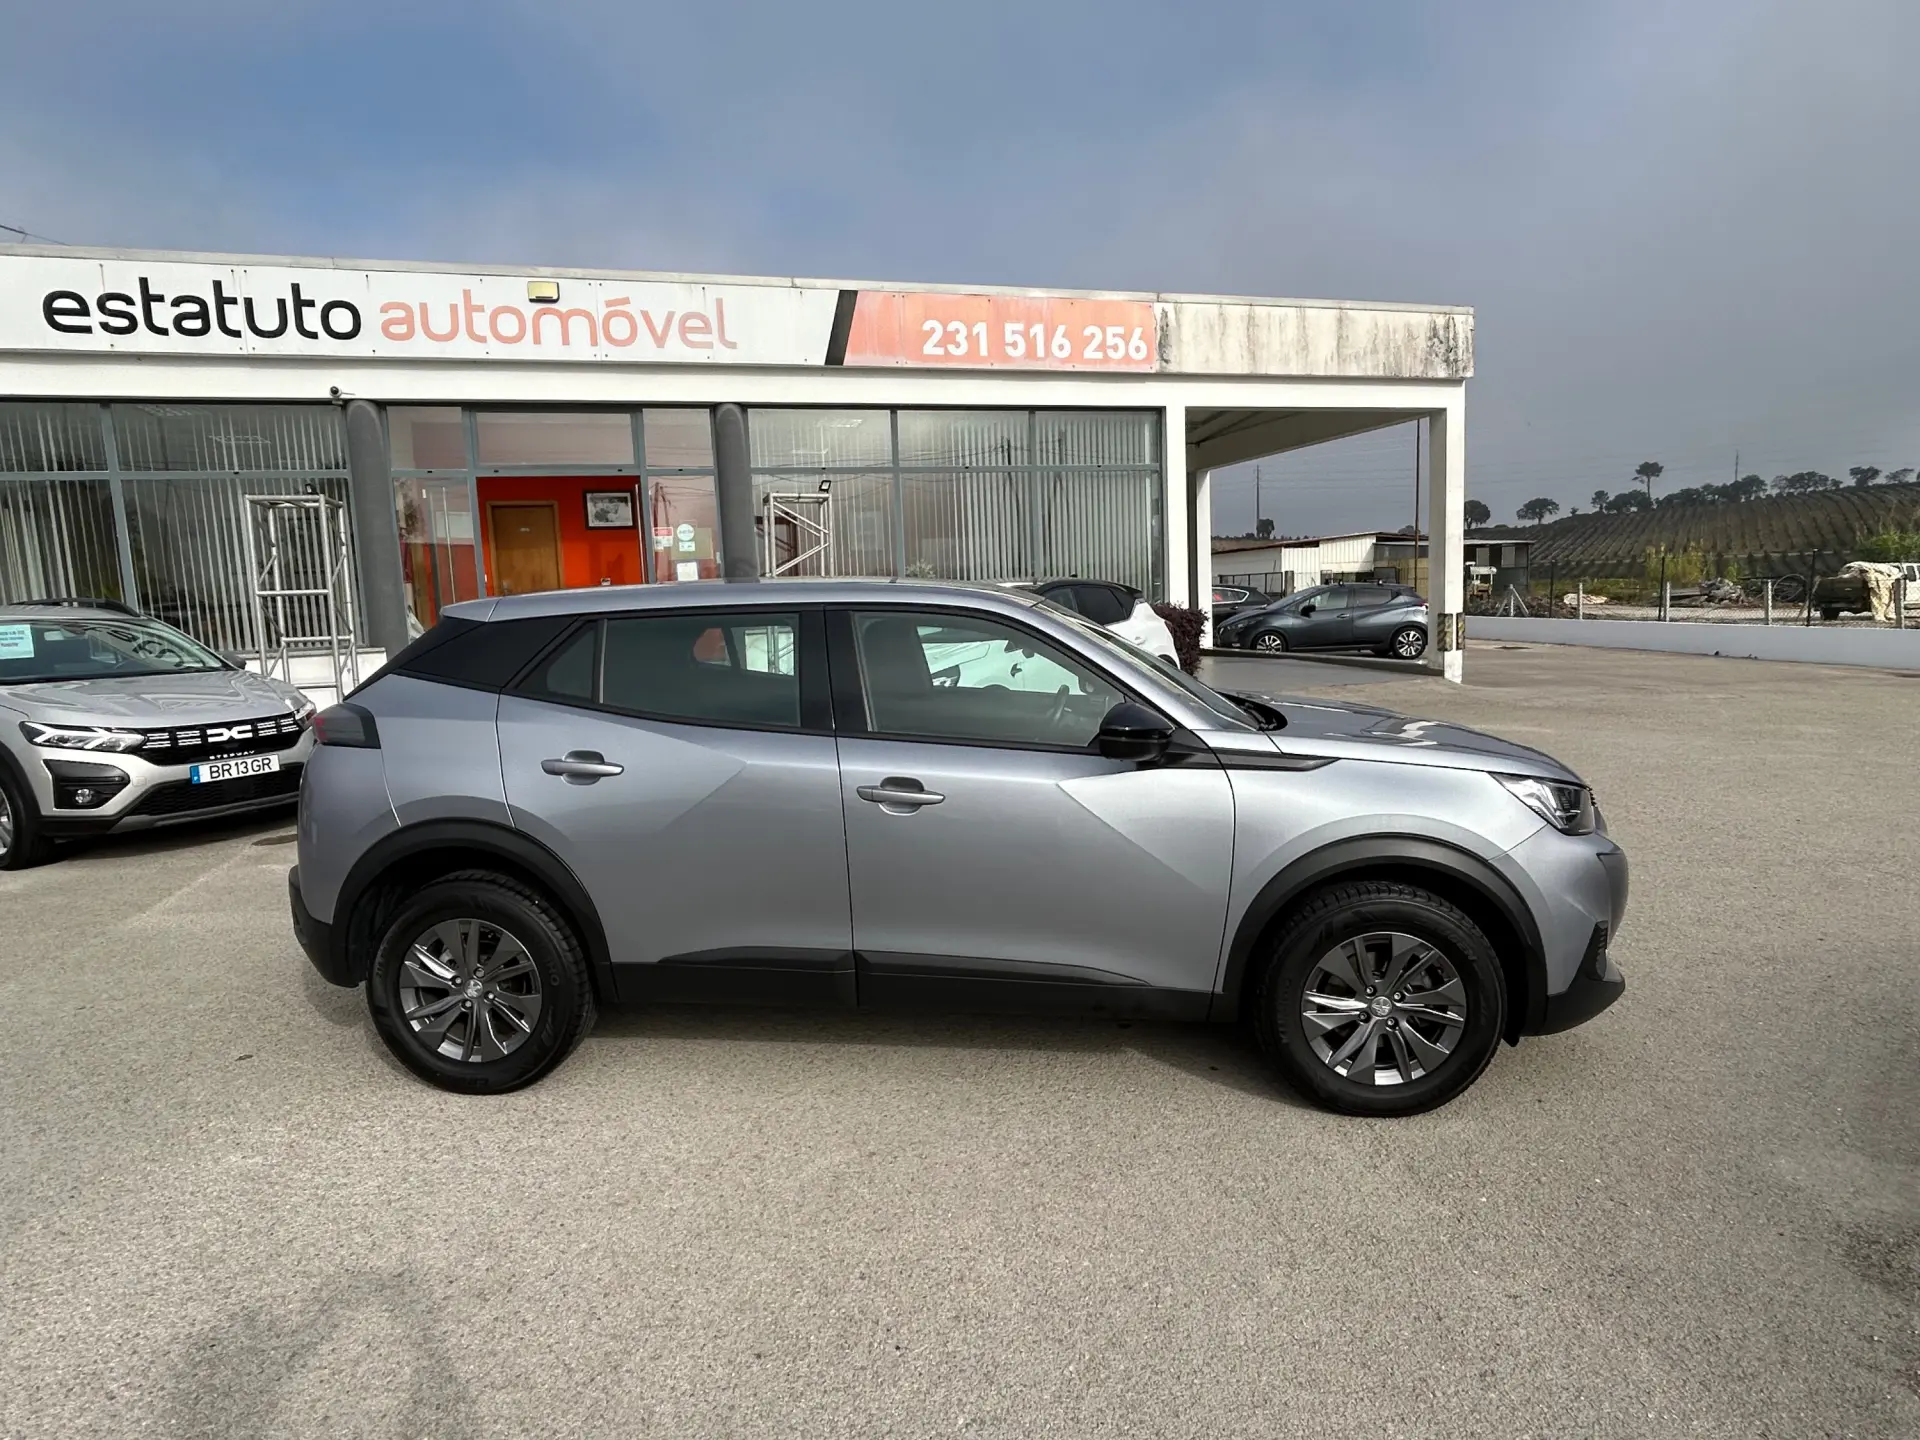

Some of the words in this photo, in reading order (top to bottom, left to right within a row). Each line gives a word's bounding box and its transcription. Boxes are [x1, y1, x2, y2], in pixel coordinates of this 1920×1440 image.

[42, 277, 361, 340] estatuto
[380, 289, 738, 350] automóvel
[922, 320, 989, 357] 231
[1004, 322, 1071, 359] 516
[1083, 325, 1147, 361] 256
